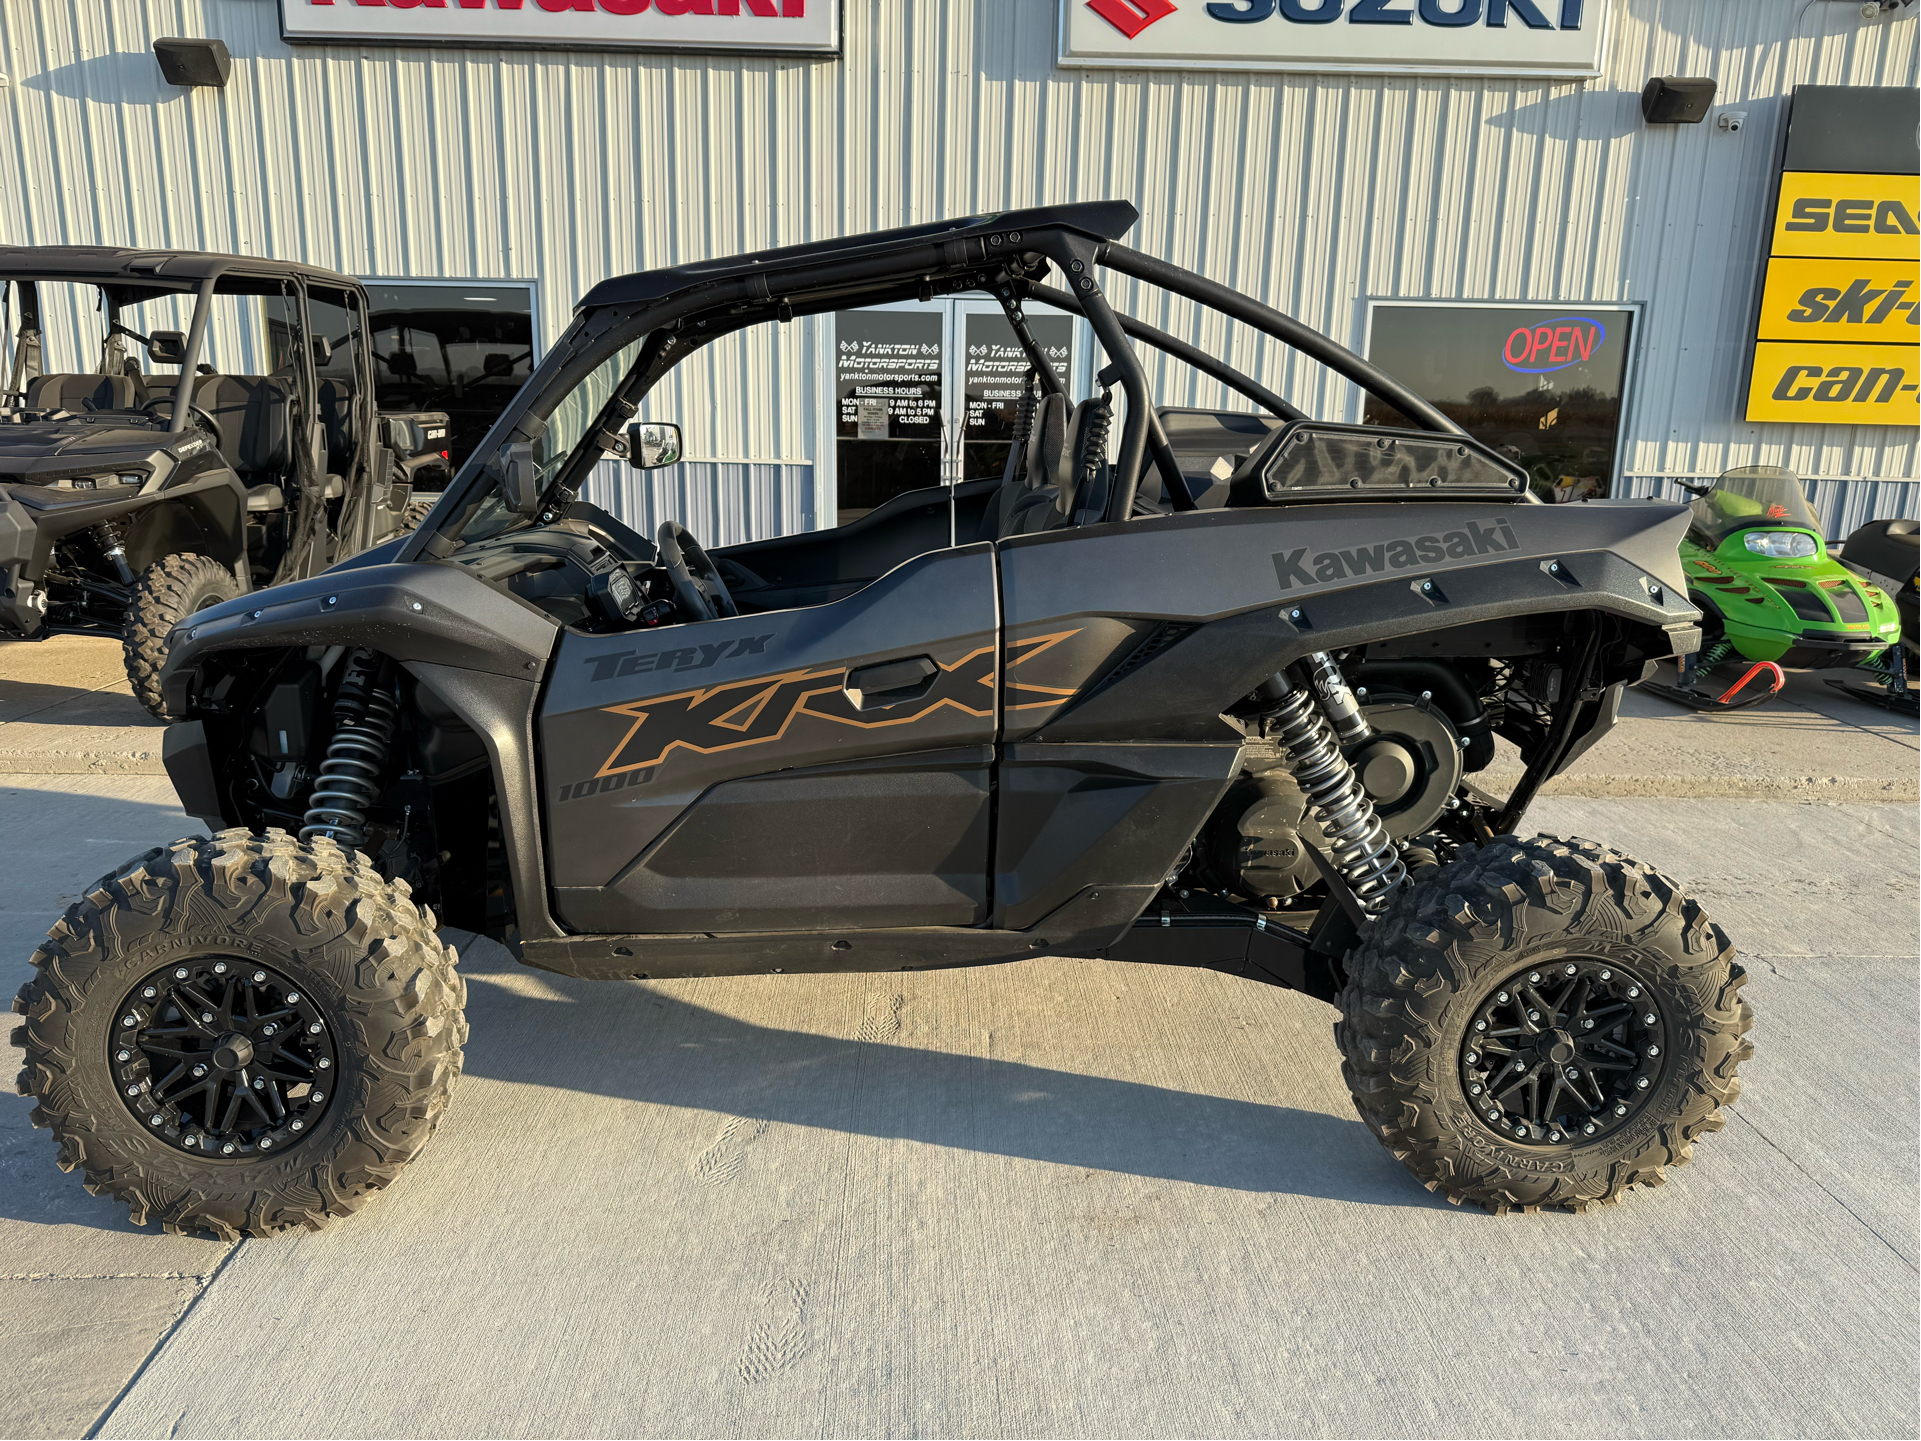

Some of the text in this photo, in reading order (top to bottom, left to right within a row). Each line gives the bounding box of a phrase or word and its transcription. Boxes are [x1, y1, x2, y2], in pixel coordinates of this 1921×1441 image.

[1785, 198, 1920, 235] SEA
[862, 341, 919, 355] YANKTON
[1504, 326, 1596, 364] OPEN
[838, 355, 939, 370] MOTORSPORTS
[967, 358, 1068, 373] MOTORSPTS
[840, 371, 938, 383] yanktonmotorsports.com
[855, 386, 922, 395] BUSINESS HOURS
[1771, 366, 1920, 404] can-
[983, 389, 1021, 398] BUSINESS
[841, 398, 859, 406] MON
[864, 398, 877, 406] FRI
[889, 399, 895, 407] 9
[896, 399, 908, 407] AM
[924, 400, 936, 408] PM
[841, 406, 856, 414] SAT
[888, 407, 893, 415] 9
[969, 401, 987, 409] MON
[969, 418, 985, 426] SUN
[1271, 516, 1521, 591] Kawasaki
[584, 633, 777, 682] TERYX
[558, 766, 656, 802] 1000
[122, 934, 265, 970] CARNIVORE
